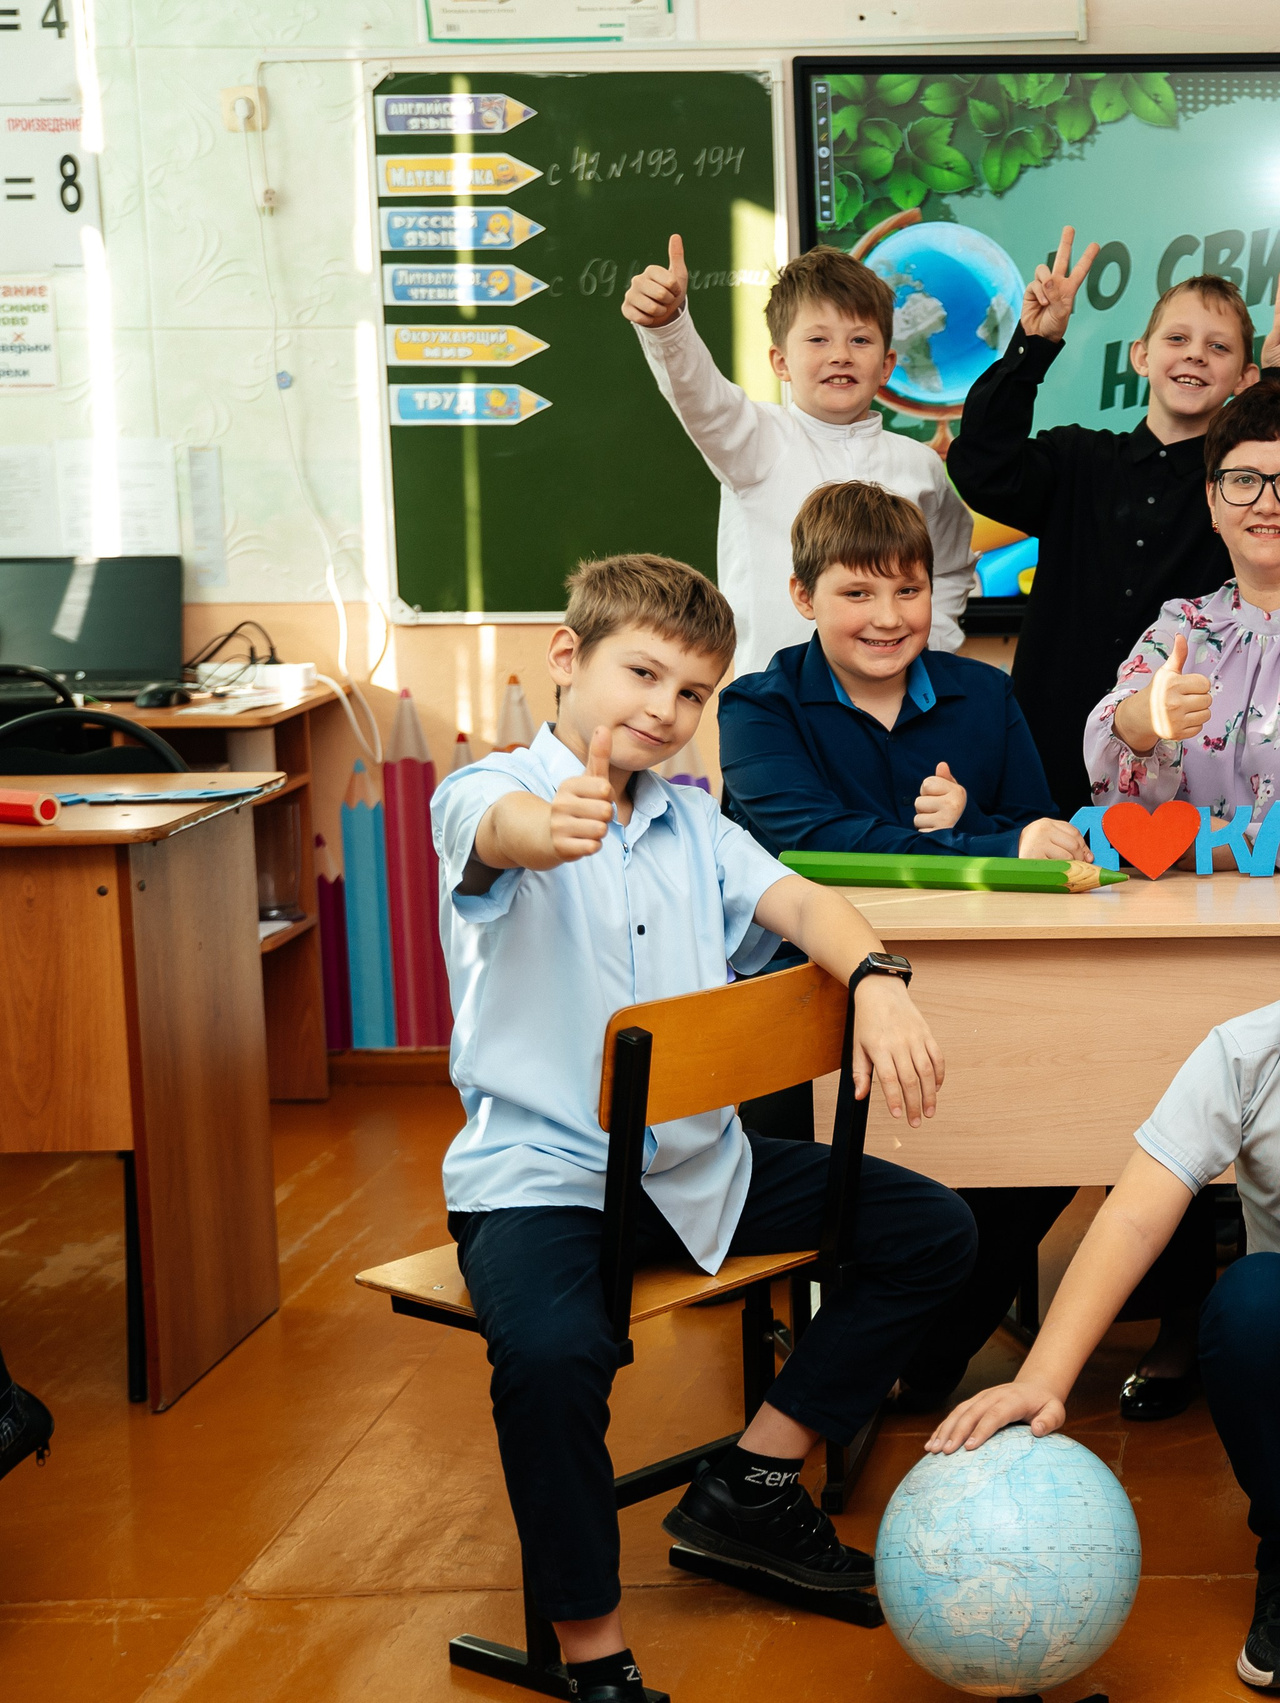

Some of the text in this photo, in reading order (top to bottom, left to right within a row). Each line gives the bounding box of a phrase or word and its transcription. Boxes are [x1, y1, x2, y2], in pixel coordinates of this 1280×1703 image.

[42, 0, 68, 39] 4
[387, 99, 475, 116] АНГЛИЙСЙ
[568, 146, 603, 182] 42
[693, 146, 746, 178] 194
[59, 153, 83, 213] 8
[390, 167, 496, 188] МАТЕМКА
[391, 212, 478, 229] РУССКЙ
[395, 269, 482, 287] ЛИТЕРАТУОЕ
[407, 287, 465, 301] ЧТЕНИ
[412, 391, 476, 415] ТРУД
